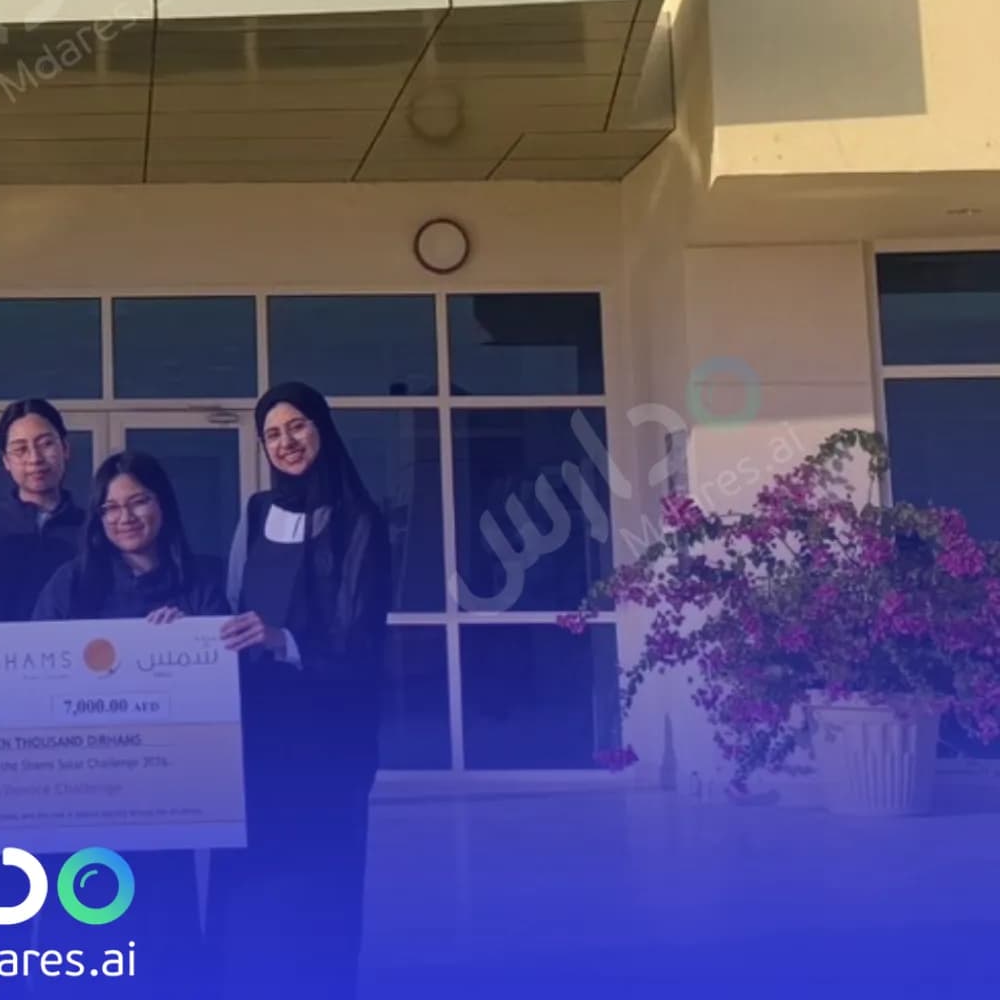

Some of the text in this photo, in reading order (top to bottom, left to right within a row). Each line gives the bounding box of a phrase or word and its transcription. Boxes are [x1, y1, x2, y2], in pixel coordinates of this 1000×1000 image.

[63, 698, 161, 716] 7,000.00 AED
[14, 734, 84, 751] THOUSAND
